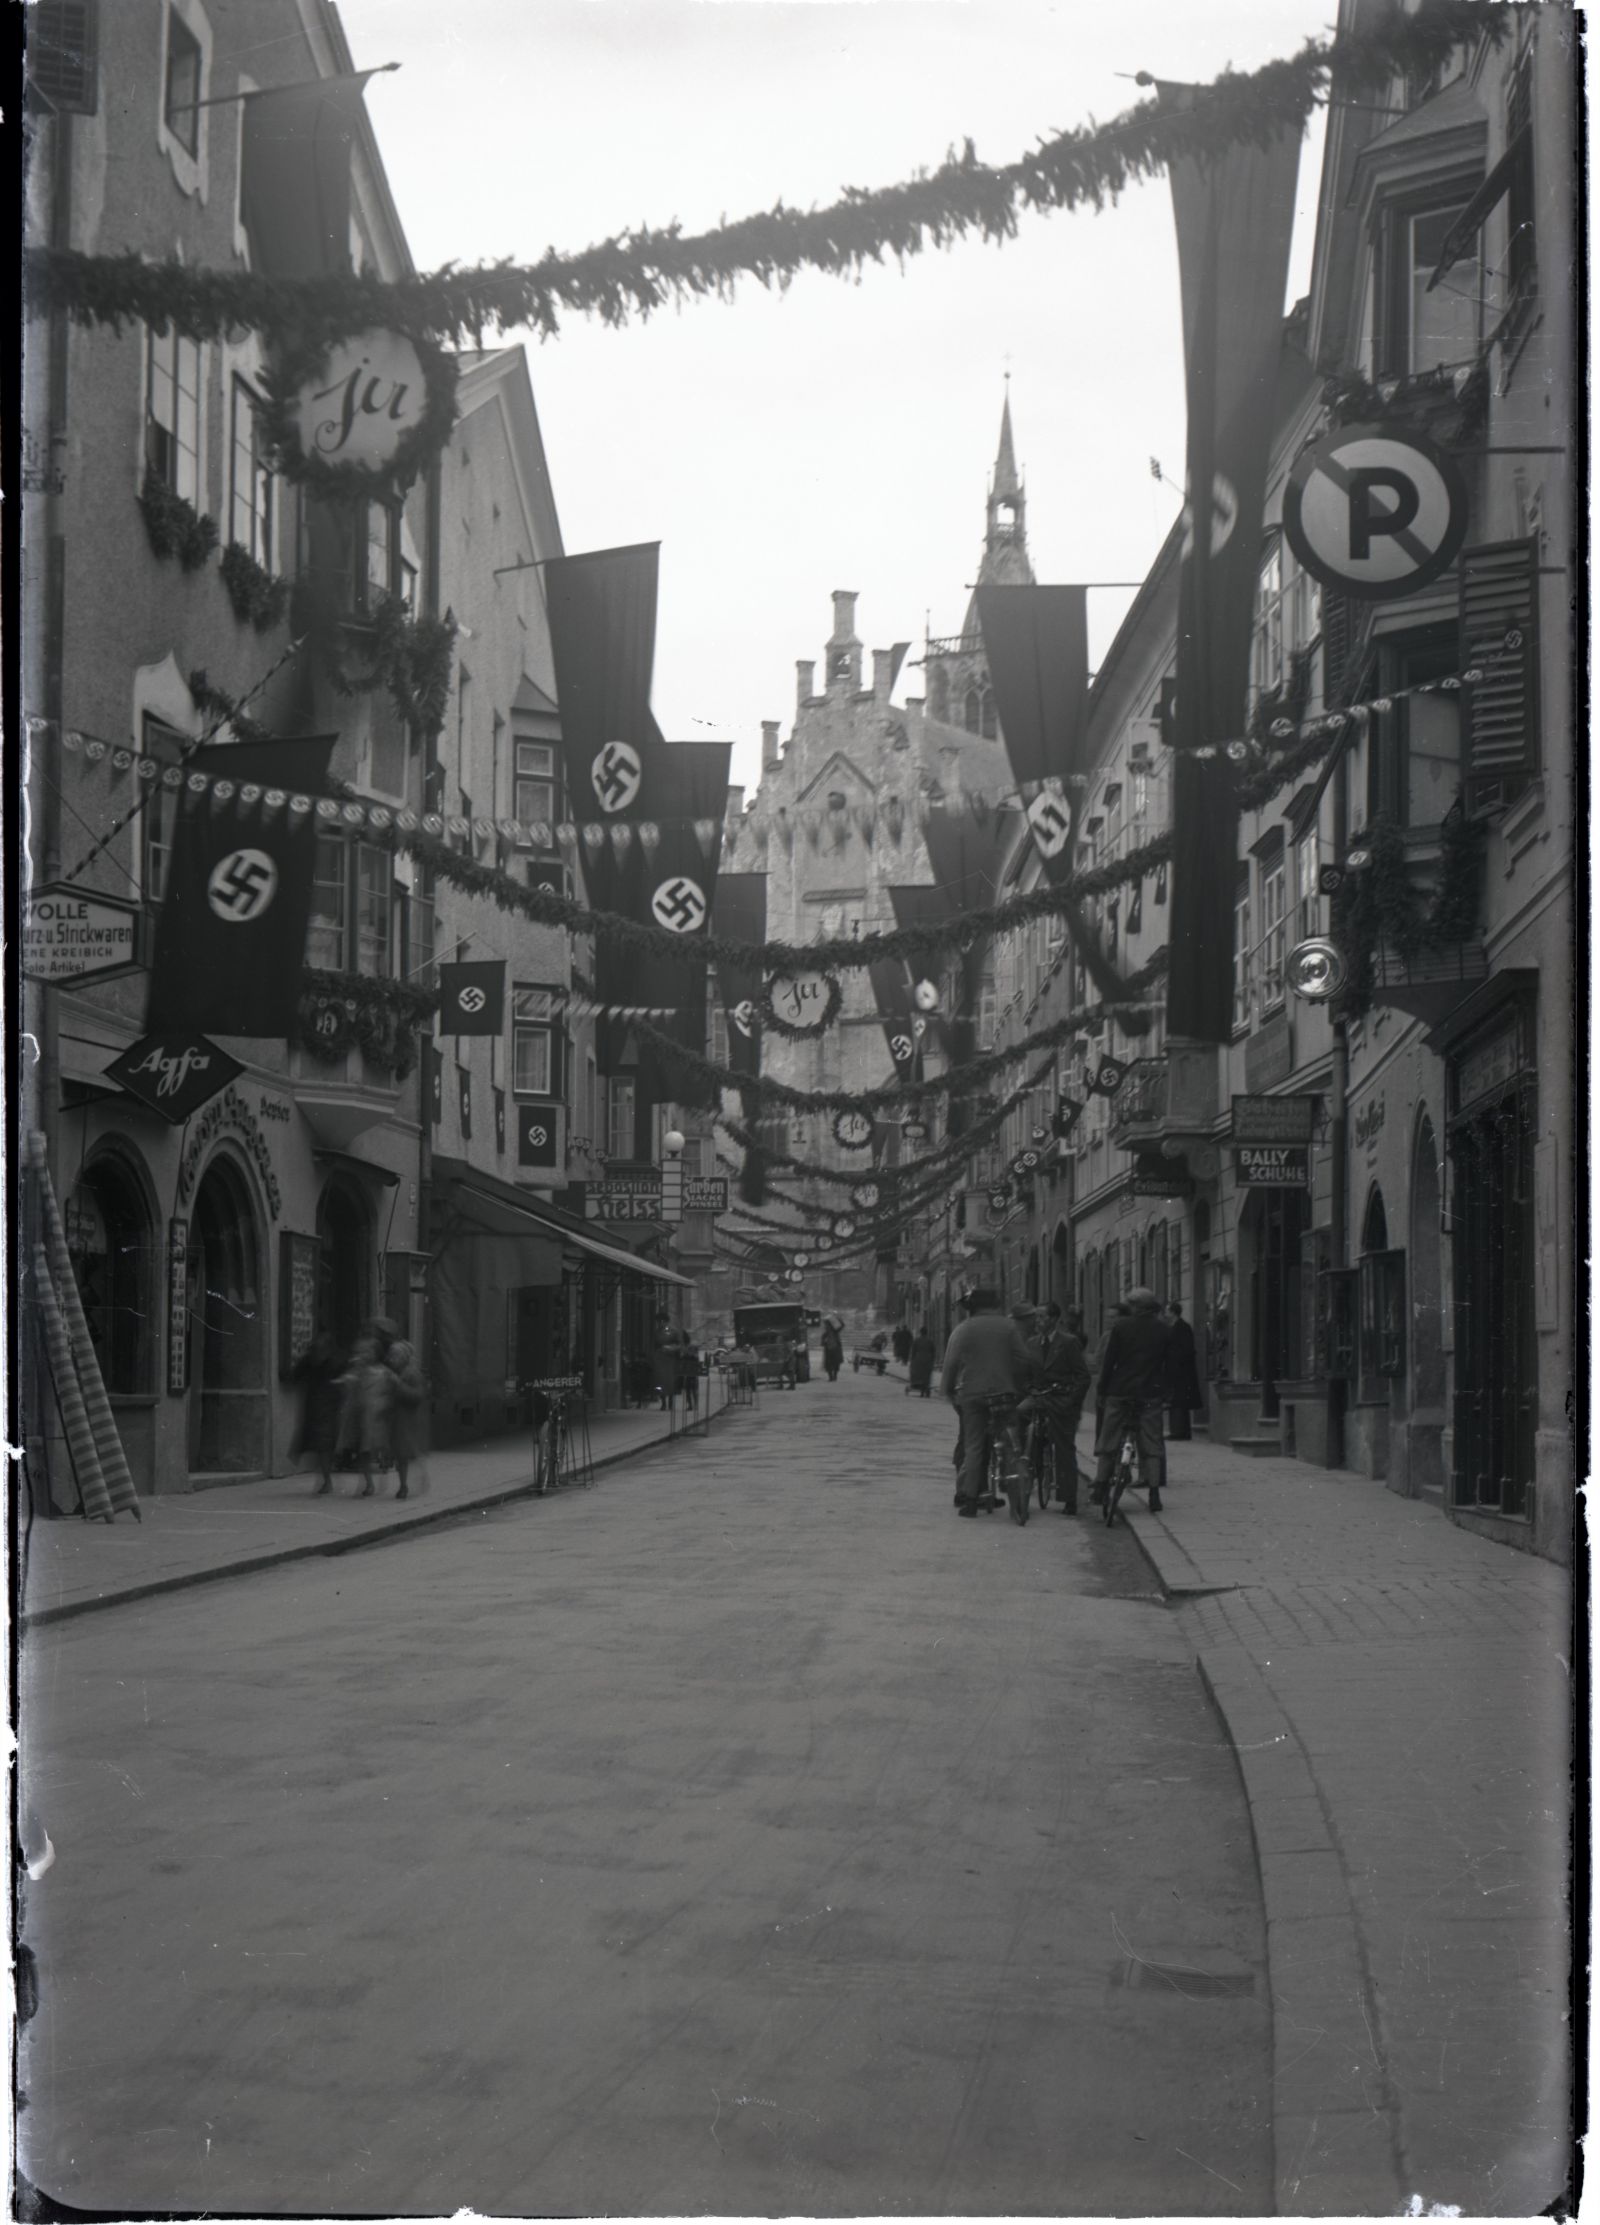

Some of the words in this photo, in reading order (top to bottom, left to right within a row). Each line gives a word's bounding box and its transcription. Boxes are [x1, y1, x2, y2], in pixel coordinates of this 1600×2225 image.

[1350, 466, 1420, 560] P
[56, 922, 132, 944] Strickwaren
[52, 947, 112, 957] KREIBICH
[49, 960, 85, 973] Artikel
[127, 1046, 211, 1097] Agfa
[1240, 1149, 1290, 1166] BALLY
[1248, 1165, 1305, 1181] SCHUHE
[532, 1376, 582, 1388] ANGERER
